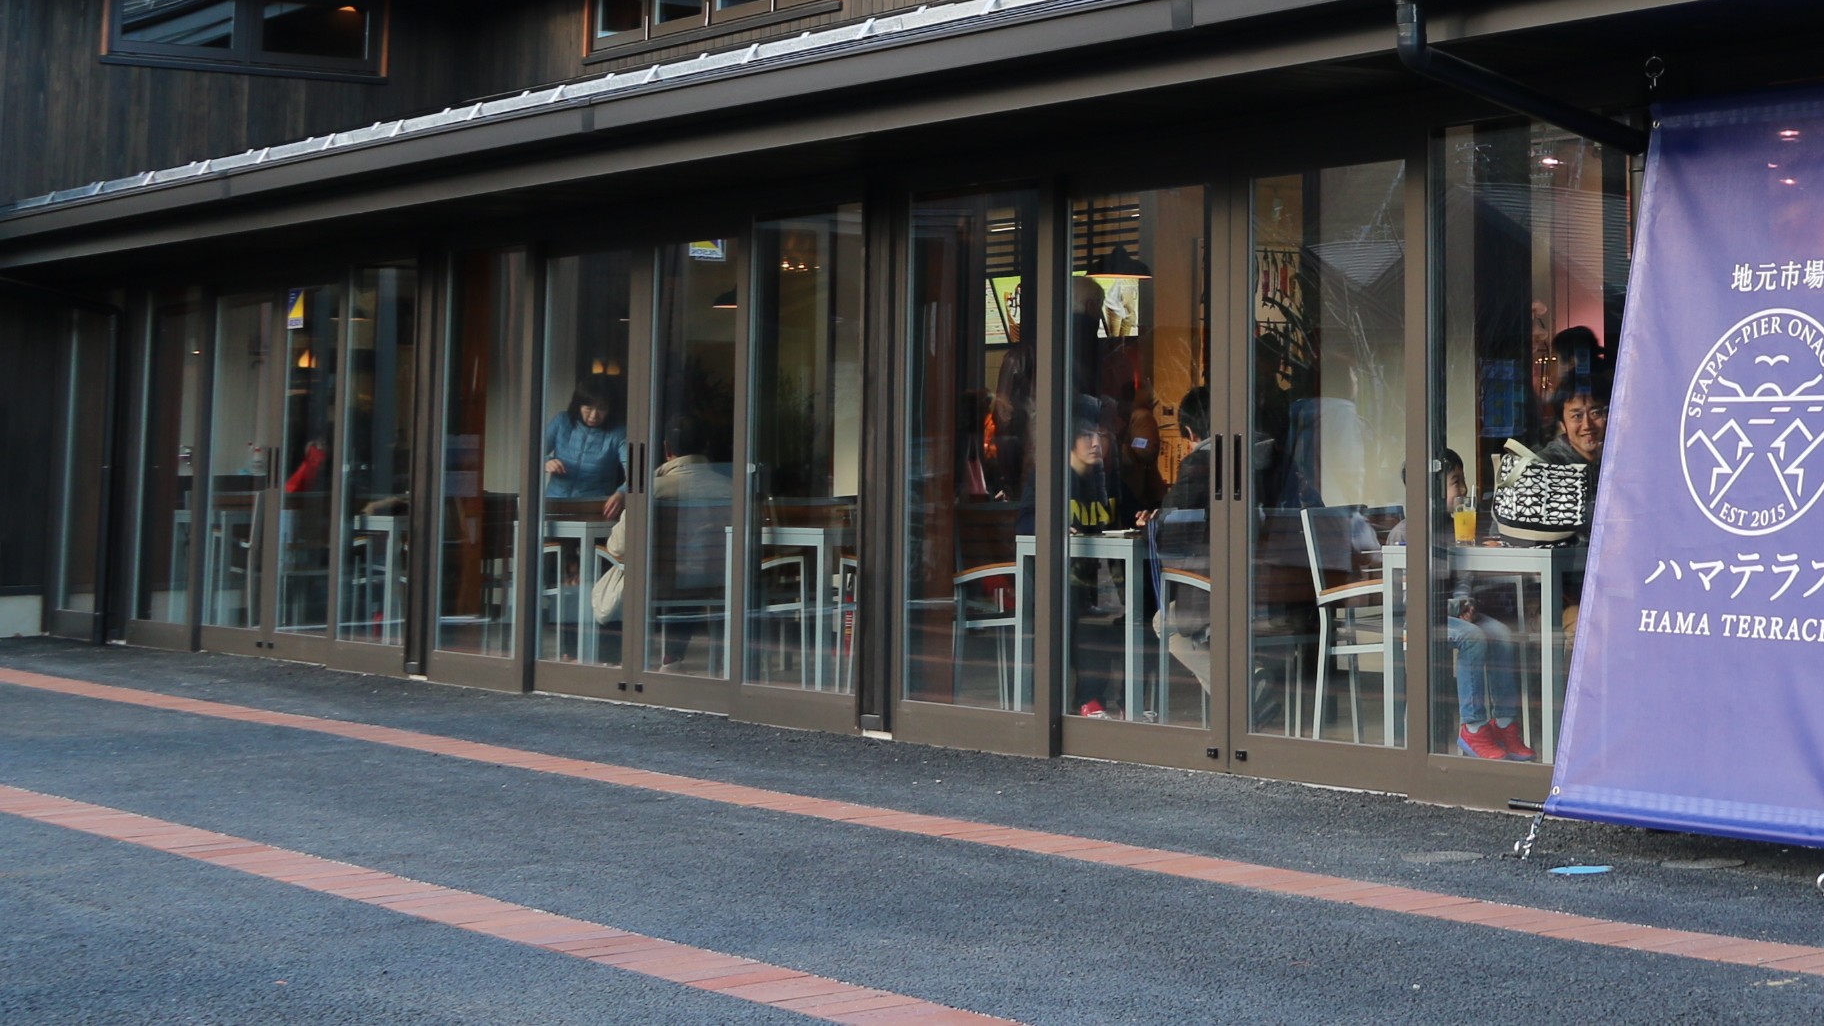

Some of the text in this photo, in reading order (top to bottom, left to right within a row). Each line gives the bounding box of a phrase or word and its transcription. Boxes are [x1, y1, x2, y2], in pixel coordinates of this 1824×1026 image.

[1688, 316, 1782, 418] SEAPAL-PIER
[1719, 501, 1787, 527] EST 2015
[1638, 609, 1711, 636] HAMA
